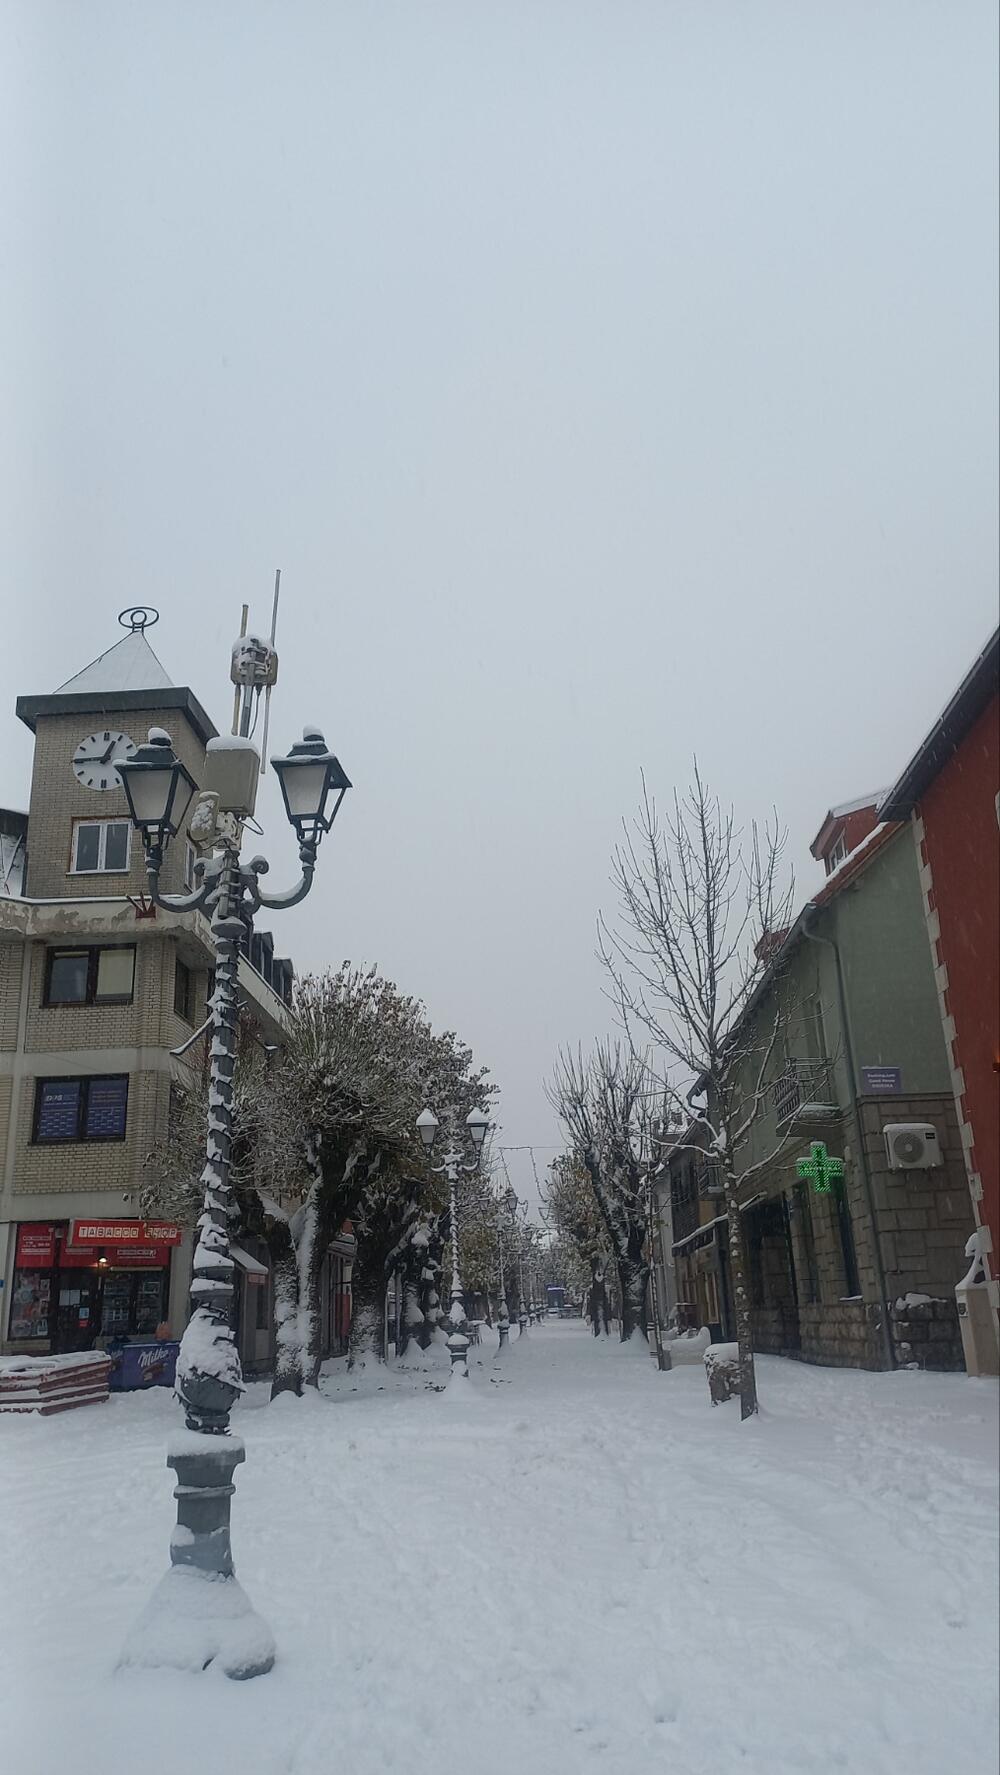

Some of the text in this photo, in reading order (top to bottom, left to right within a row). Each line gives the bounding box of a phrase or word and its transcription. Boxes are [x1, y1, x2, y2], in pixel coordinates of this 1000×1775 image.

[78, 1227, 178, 1238] TABACCO SHOP
[137, 1347, 169, 1368] Milka
